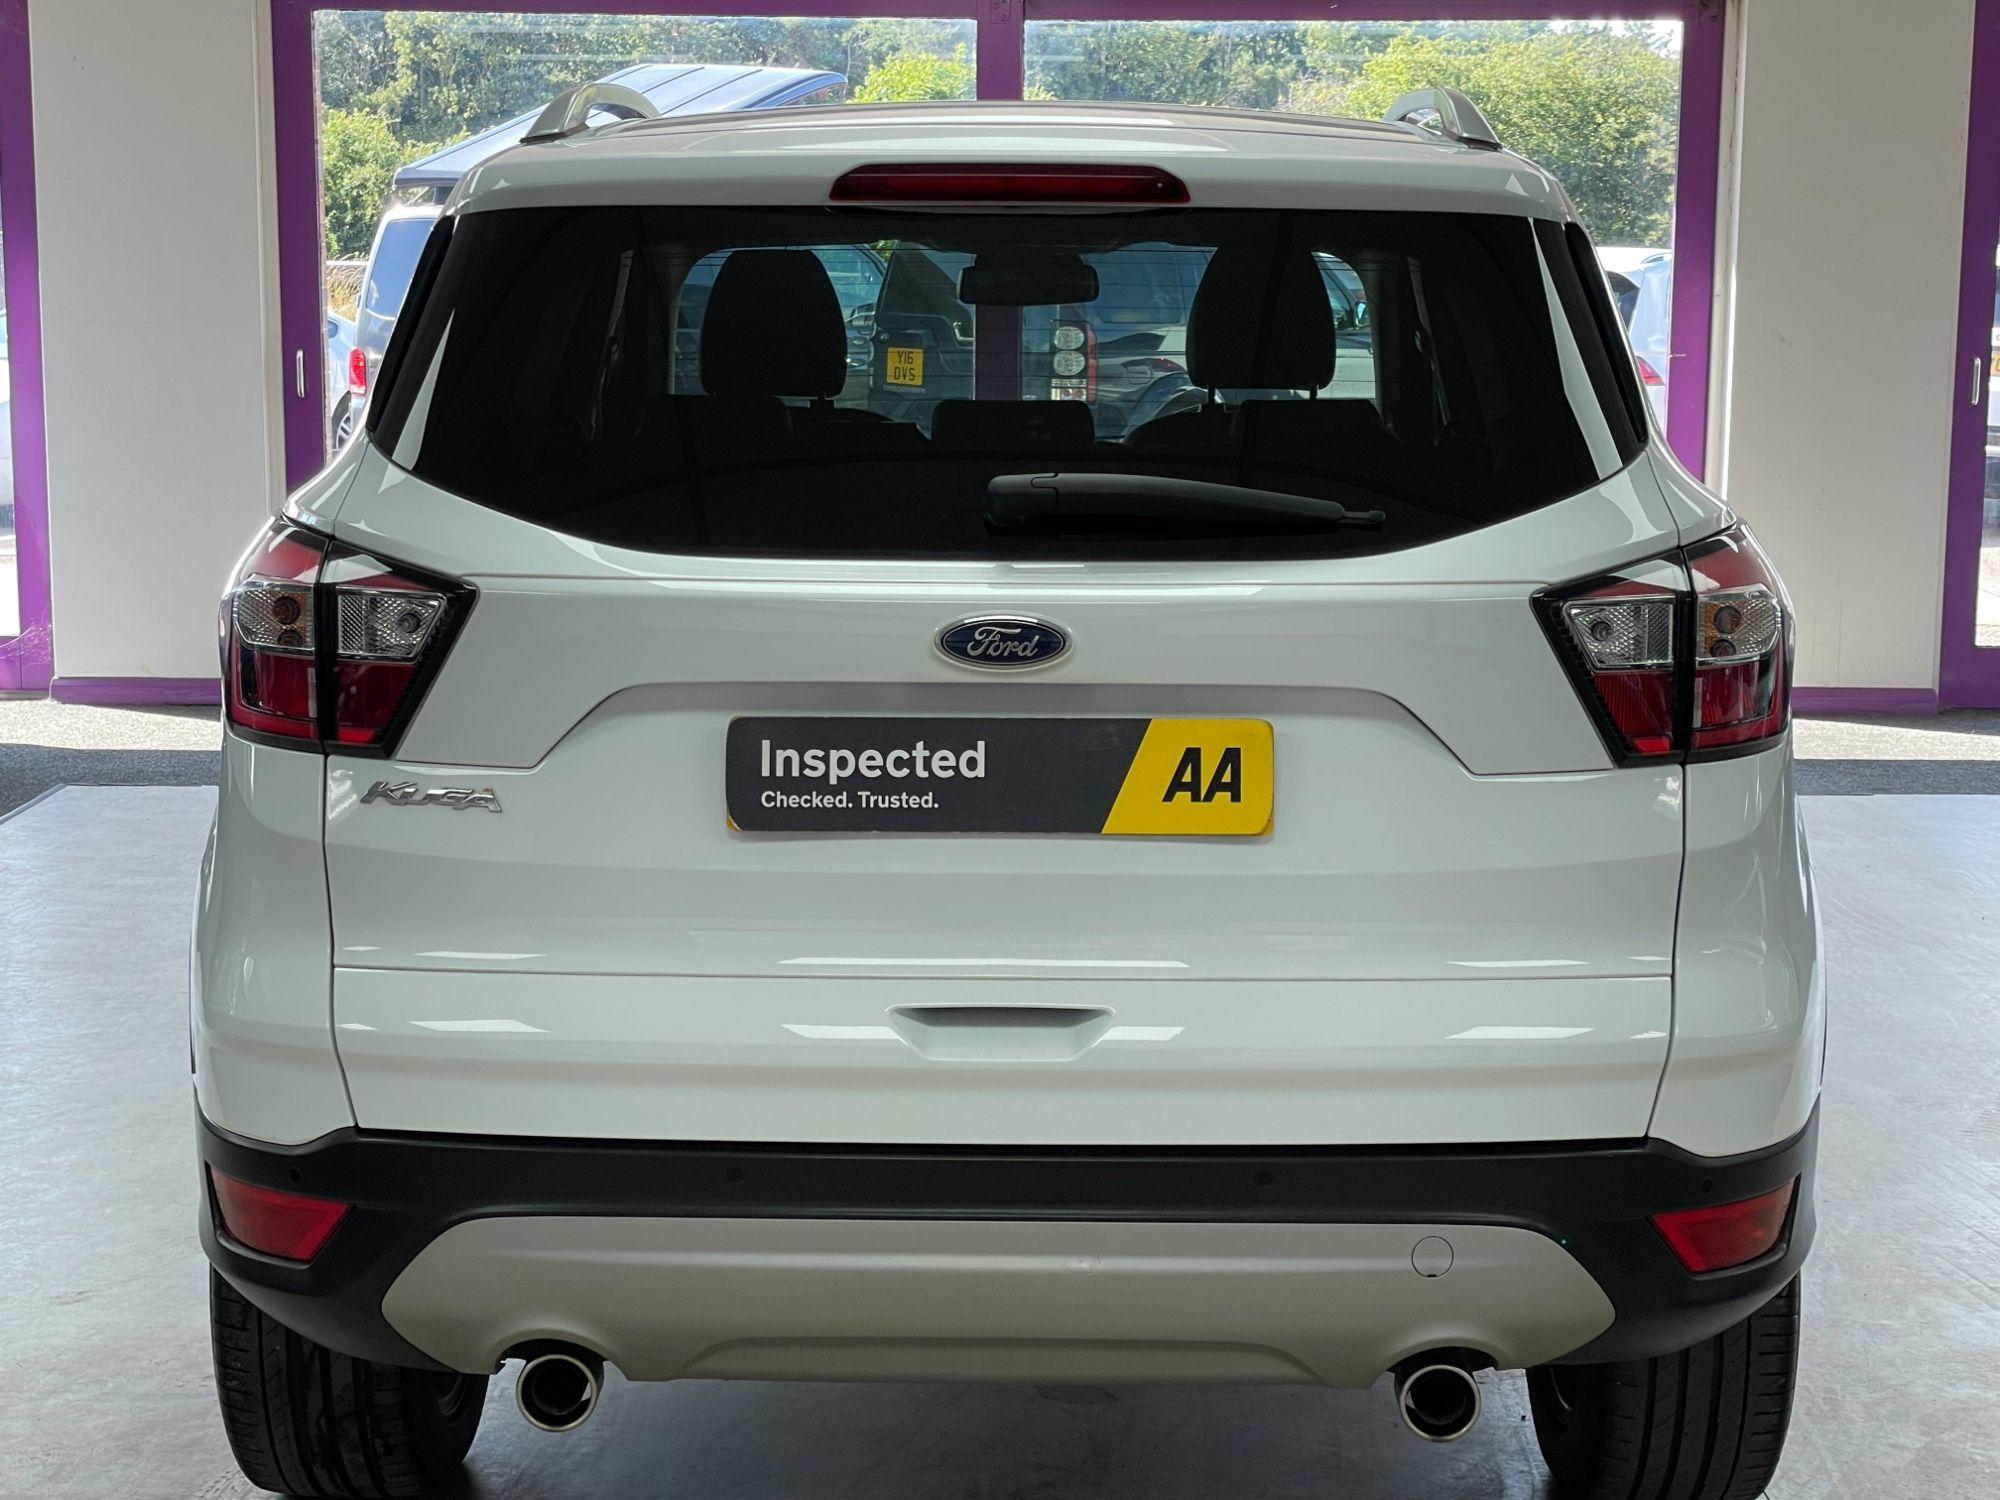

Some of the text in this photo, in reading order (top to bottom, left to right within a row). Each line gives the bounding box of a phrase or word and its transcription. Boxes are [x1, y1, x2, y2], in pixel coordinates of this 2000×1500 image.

[897, 350, 914, 364] Y16
[894, 366, 916, 382] DVS
[966, 626, 1040, 657] Ford
[761, 739, 986, 785] Inspected
[1161, 746, 1243, 803] AA
[359, 780, 504, 814] KUGA
[761, 790, 939, 809] Checked. Trusted.
